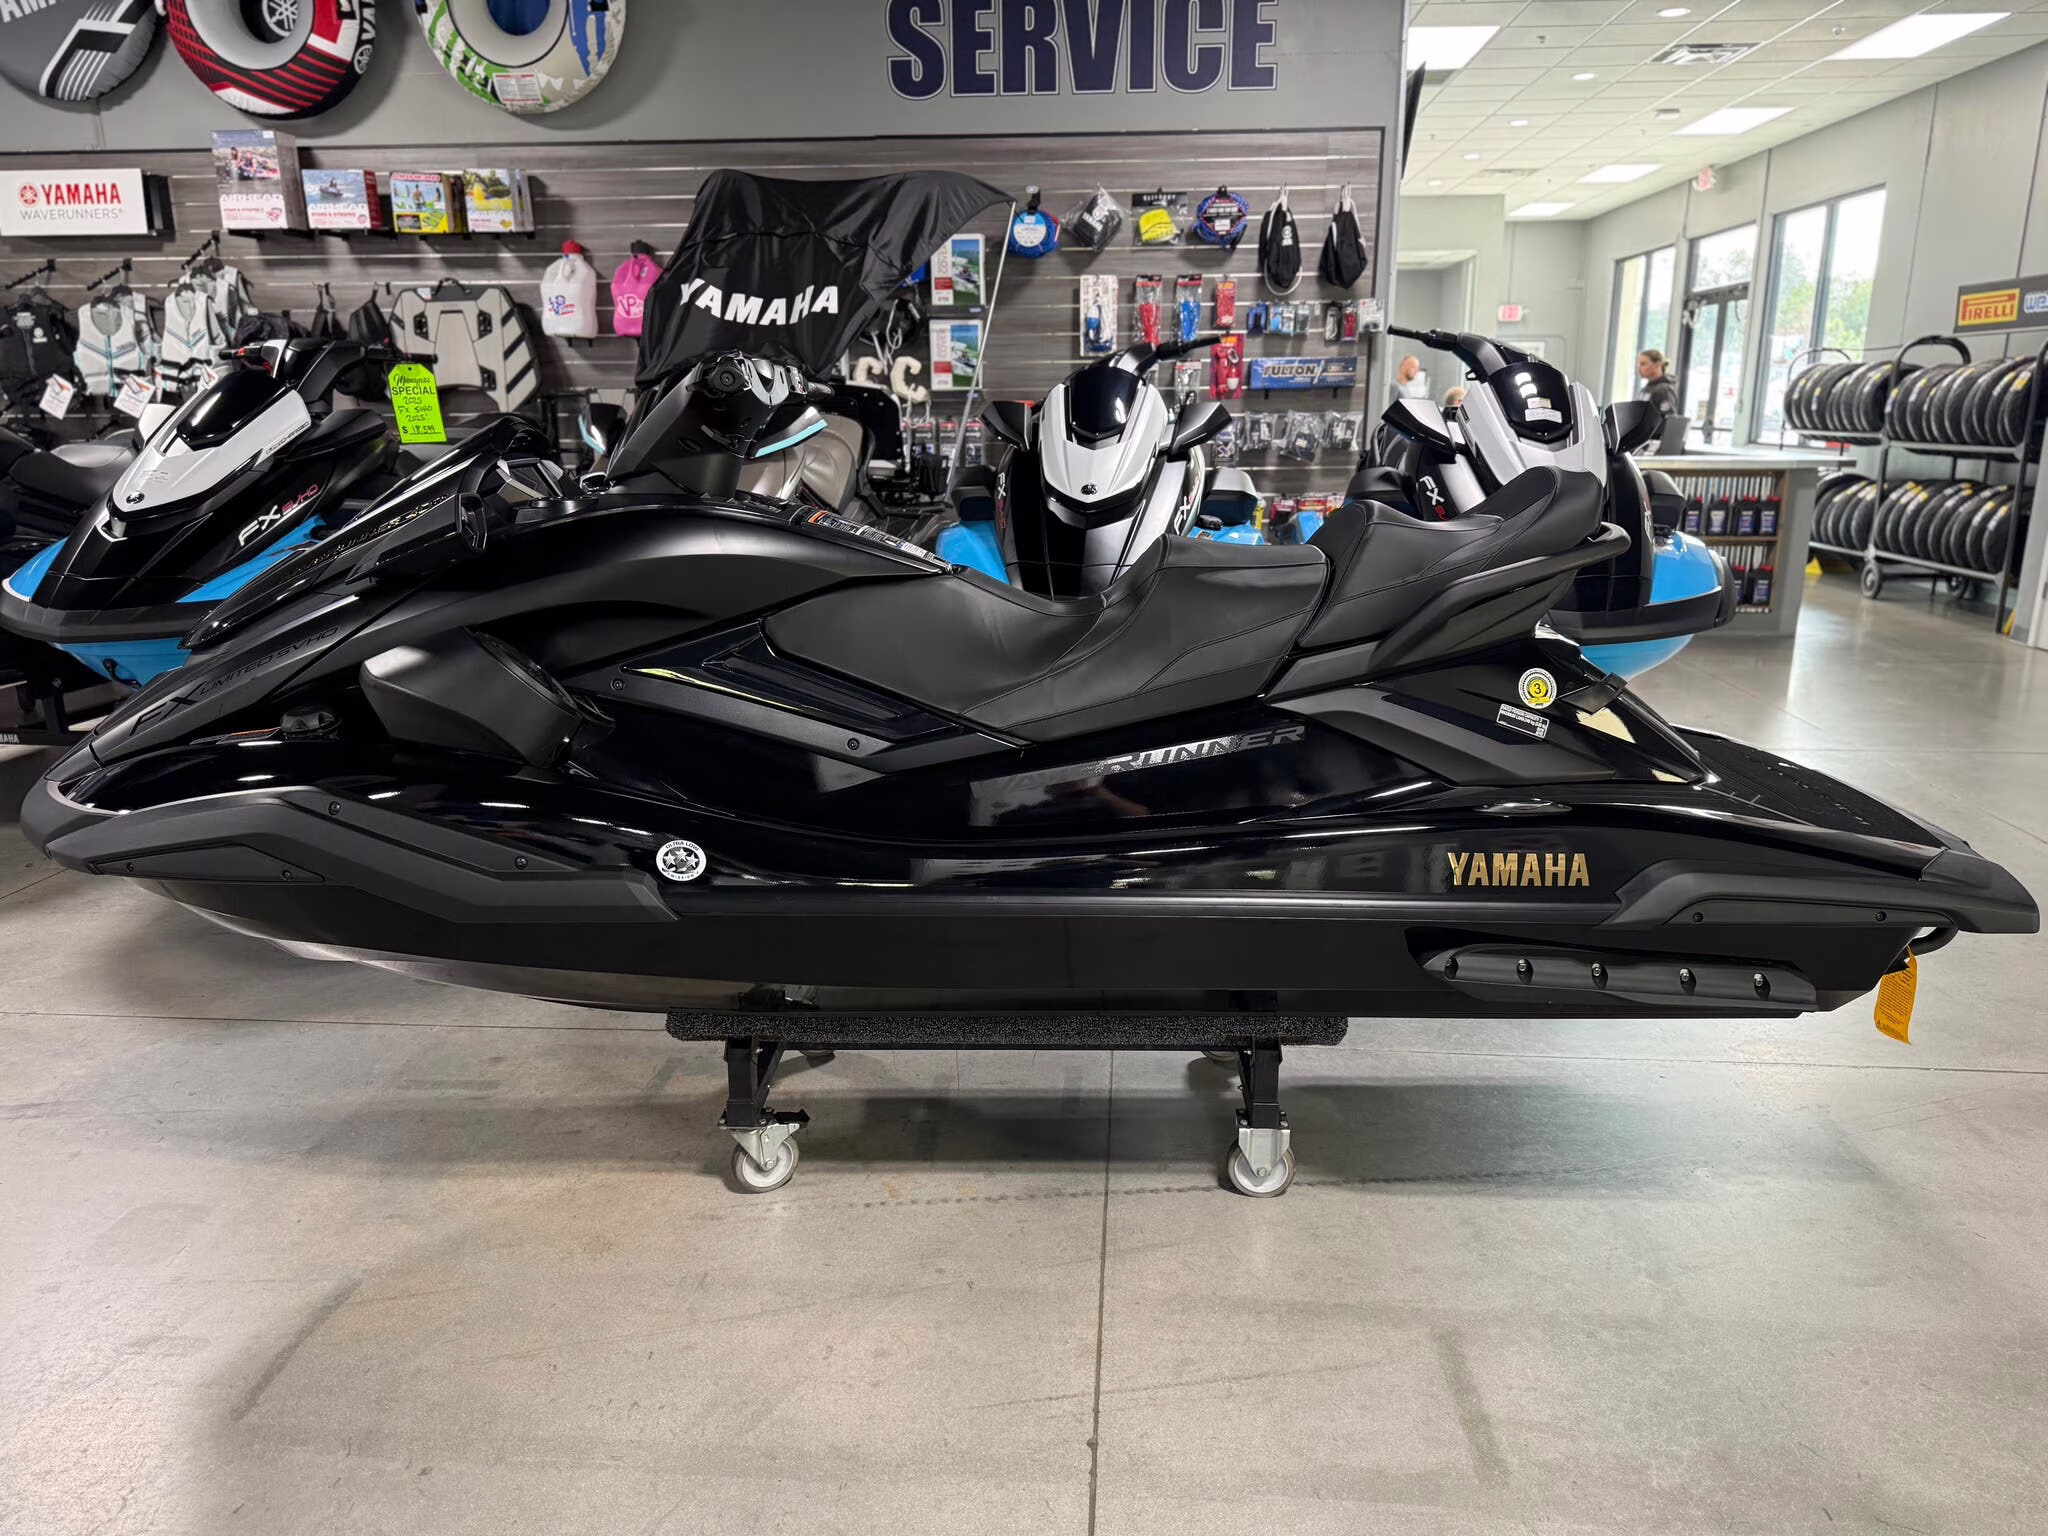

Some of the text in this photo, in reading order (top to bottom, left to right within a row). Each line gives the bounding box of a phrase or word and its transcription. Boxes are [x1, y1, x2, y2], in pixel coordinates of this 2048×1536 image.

[0, 0, 57, 23] AM
[885, 0, 1278, 100] SERVICE
[41, 182, 121, 205] YAMAHA
[679, 277, 839, 326] YAMAHA
[1961, 292, 2017, 321] PIRELLI
[1264, 363, 1317, 377] FULTON
[391, 386, 436, 396] SPECIAL
[1419, 475, 1445, 506] FX
[238, 483, 319, 547] FX SVHO
[129, 626, 343, 737] FX LIMITED SVHO
[1533, 682, 1542, 695] 3
[685, 842, 700, 850] LOW
[1447, 852, 1591, 887] YAMAHA
